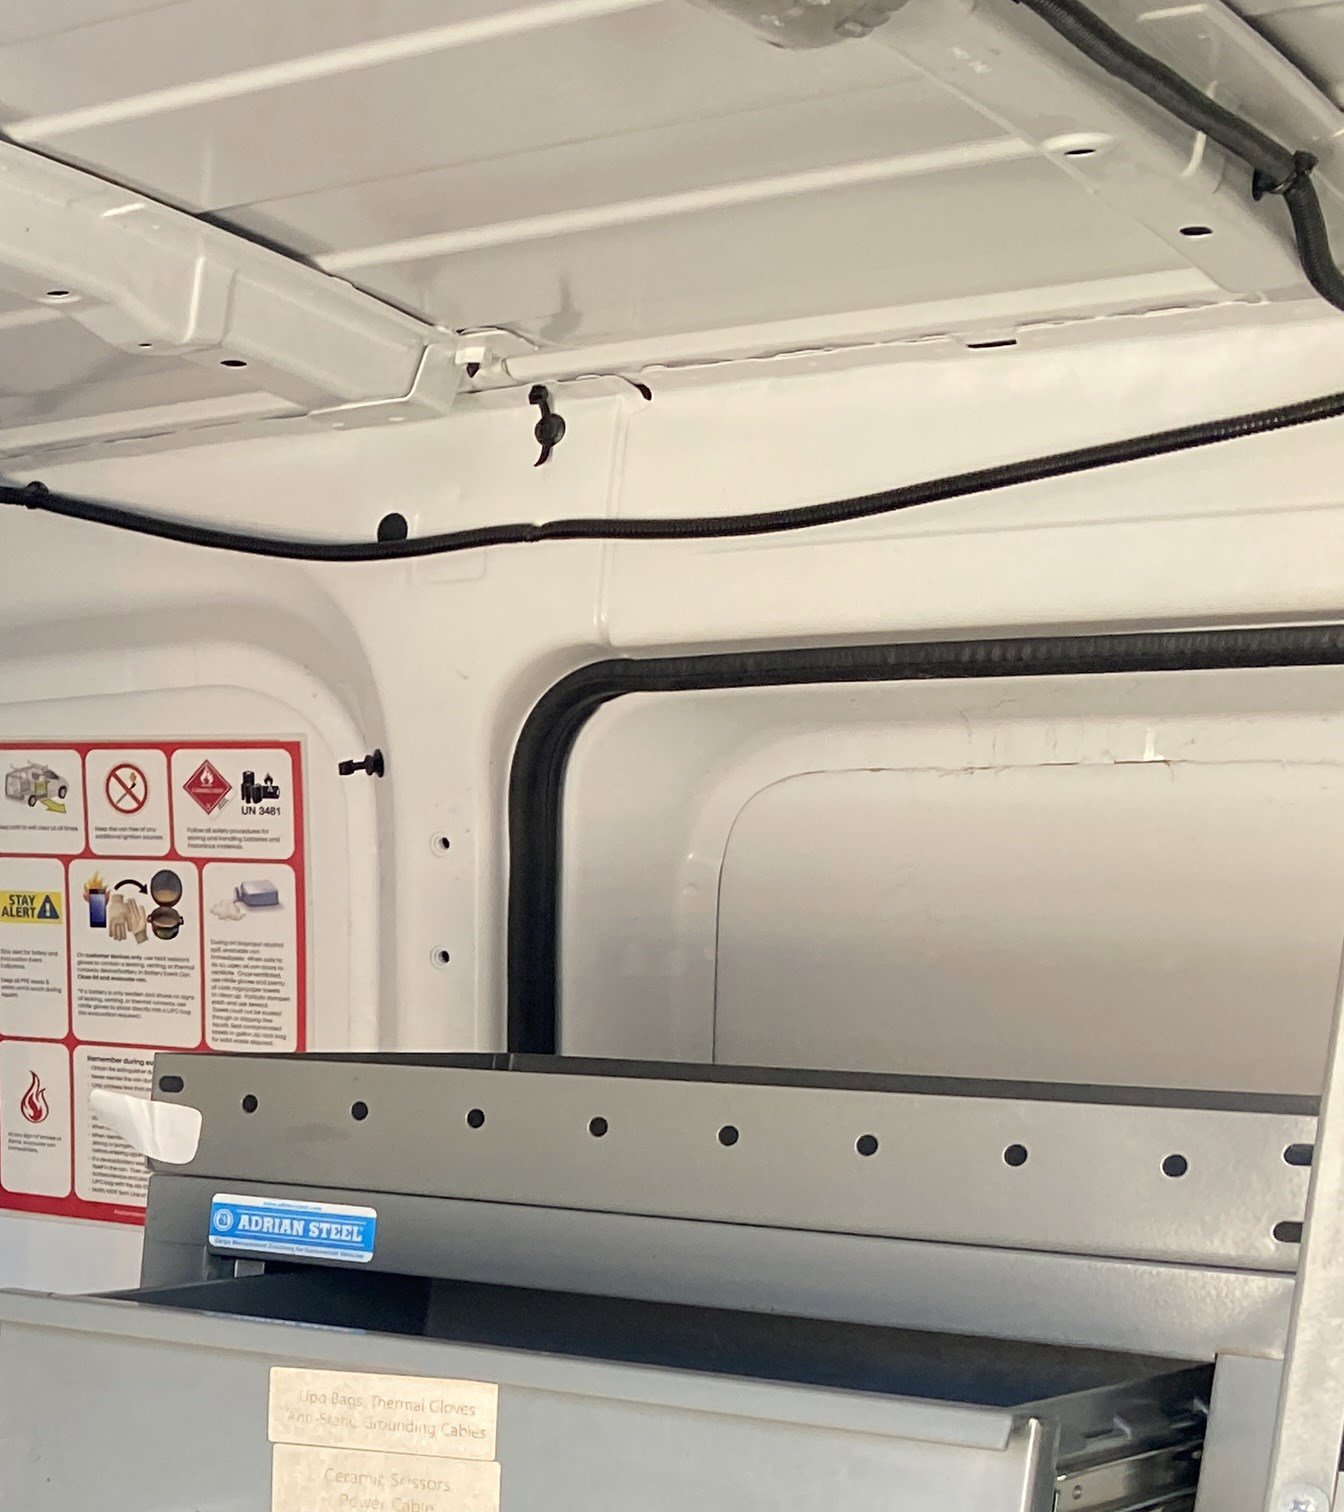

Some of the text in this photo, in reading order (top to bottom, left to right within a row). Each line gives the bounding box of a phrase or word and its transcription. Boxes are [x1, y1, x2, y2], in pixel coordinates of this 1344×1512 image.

[241, 806, 256, 816] UN
[8, 894, 36, 906] STAY
[1, 906, 36, 919] ALERT
[238, 1214, 363, 1242] ADRIAN STEEL
[371, 1394, 425, 1412] Thermal
[430, 1399, 476, 1416] Gloves
[441, 1423, 486, 1439] Cables
